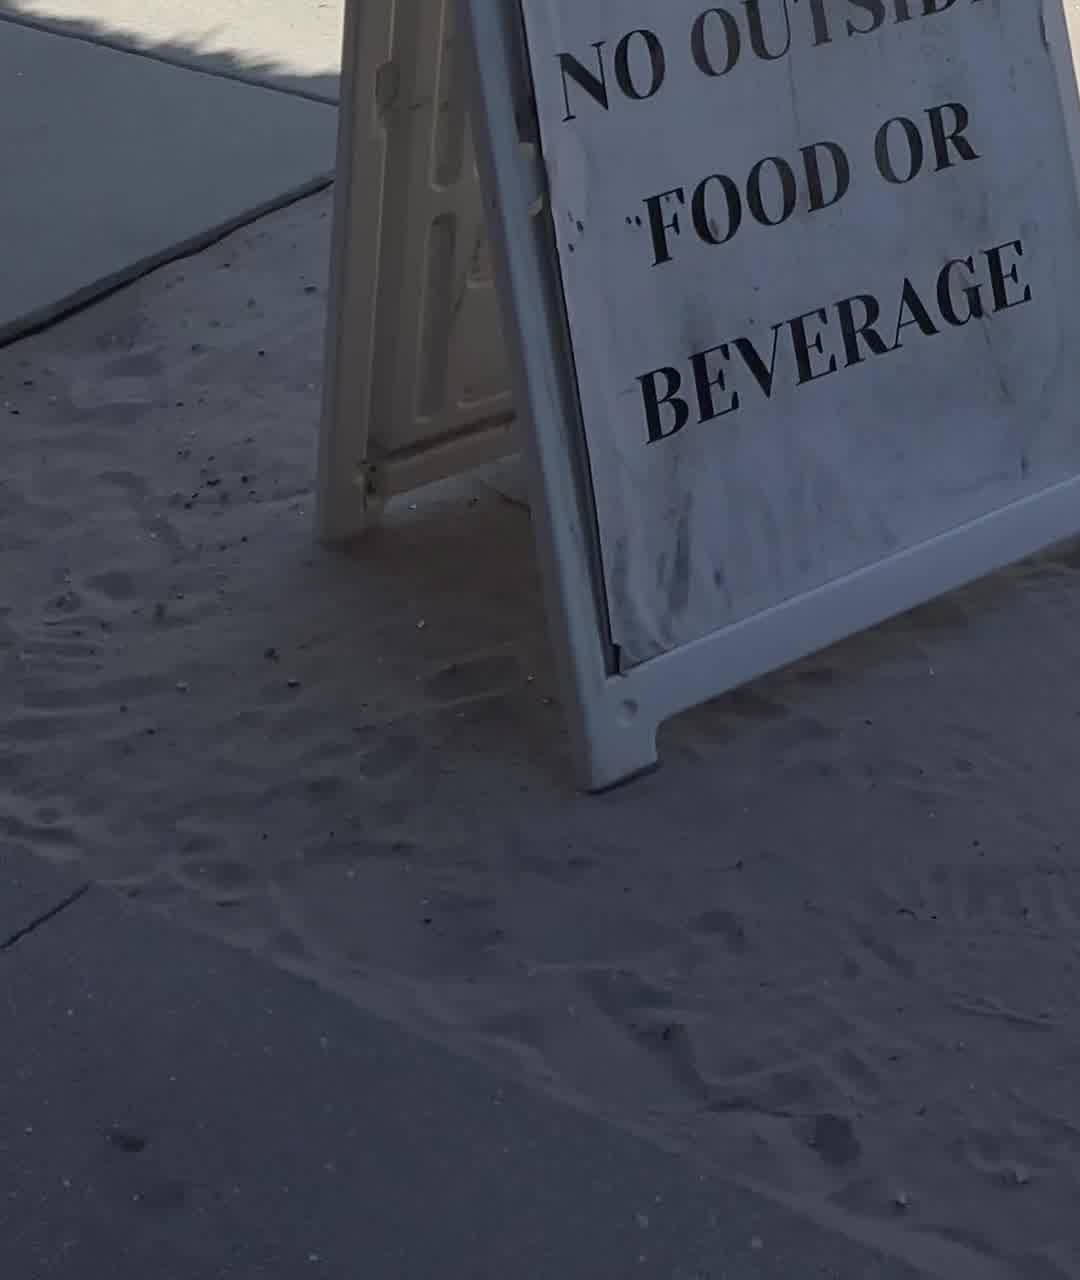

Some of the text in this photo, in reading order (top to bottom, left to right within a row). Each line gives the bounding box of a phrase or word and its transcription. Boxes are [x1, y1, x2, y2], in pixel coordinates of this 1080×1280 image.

[555, 29, 666, 122] NO
[642, 102, 981, 267] FOOD OR
[635, 240, 1032, 445] BEVERAGE
